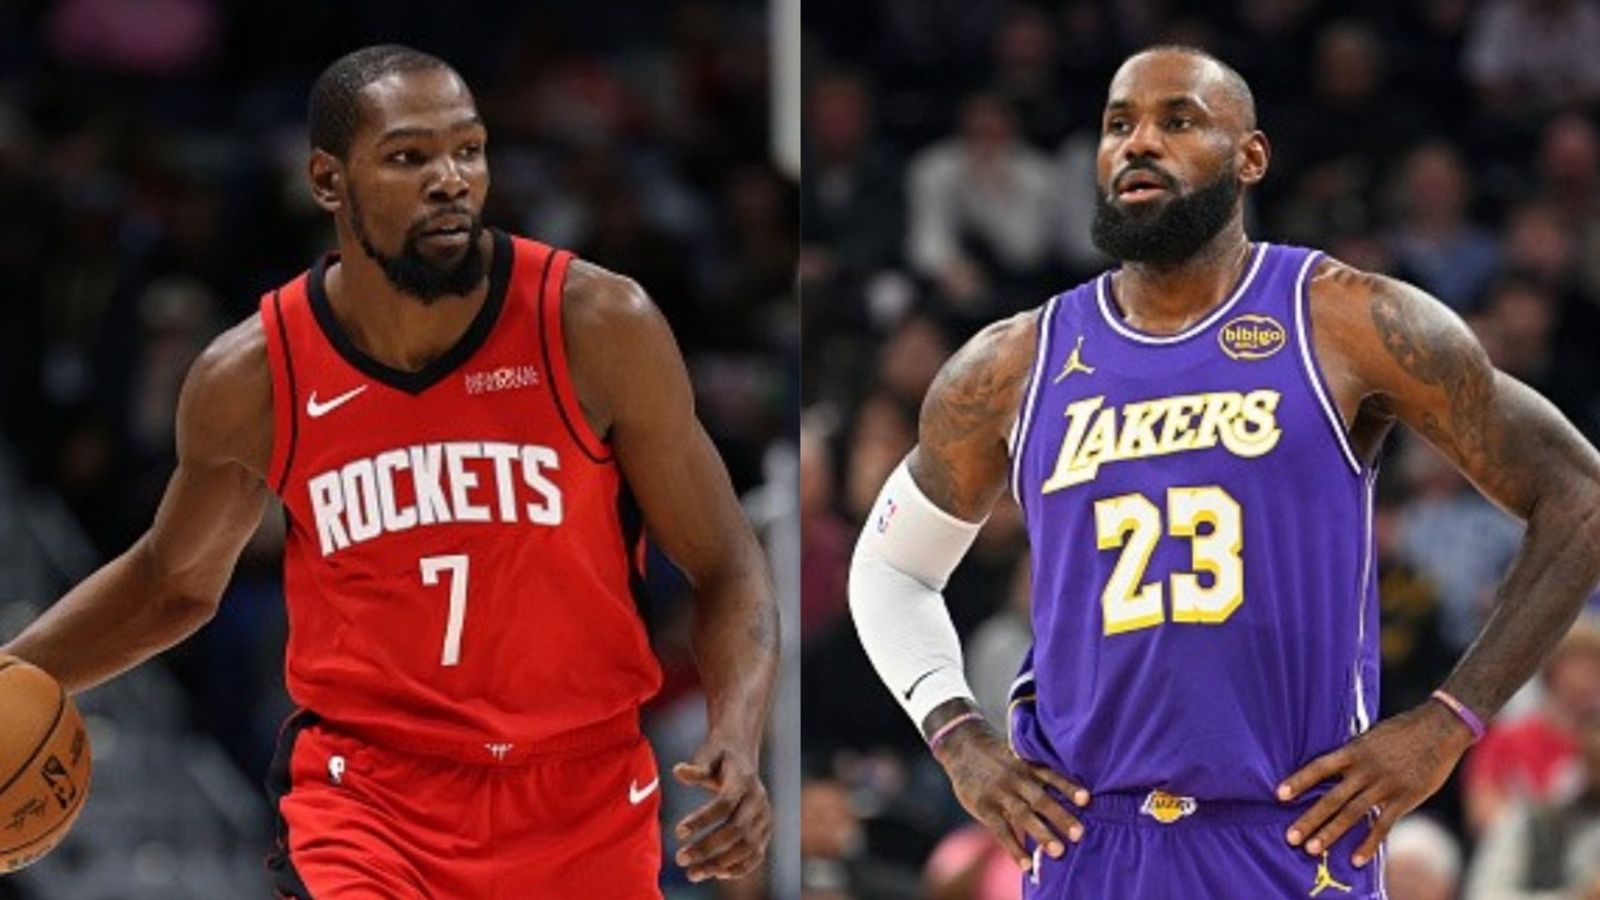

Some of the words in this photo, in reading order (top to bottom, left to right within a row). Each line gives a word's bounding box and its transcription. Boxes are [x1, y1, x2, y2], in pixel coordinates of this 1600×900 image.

[1225, 326, 1280, 346] bibigo
[1041, 389, 1282, 494] LAKERS
[308, 441, 563, 556] ROCKETS
[419, 554, 469, 666] 7
[1094, 485, 1244, 636] 23
